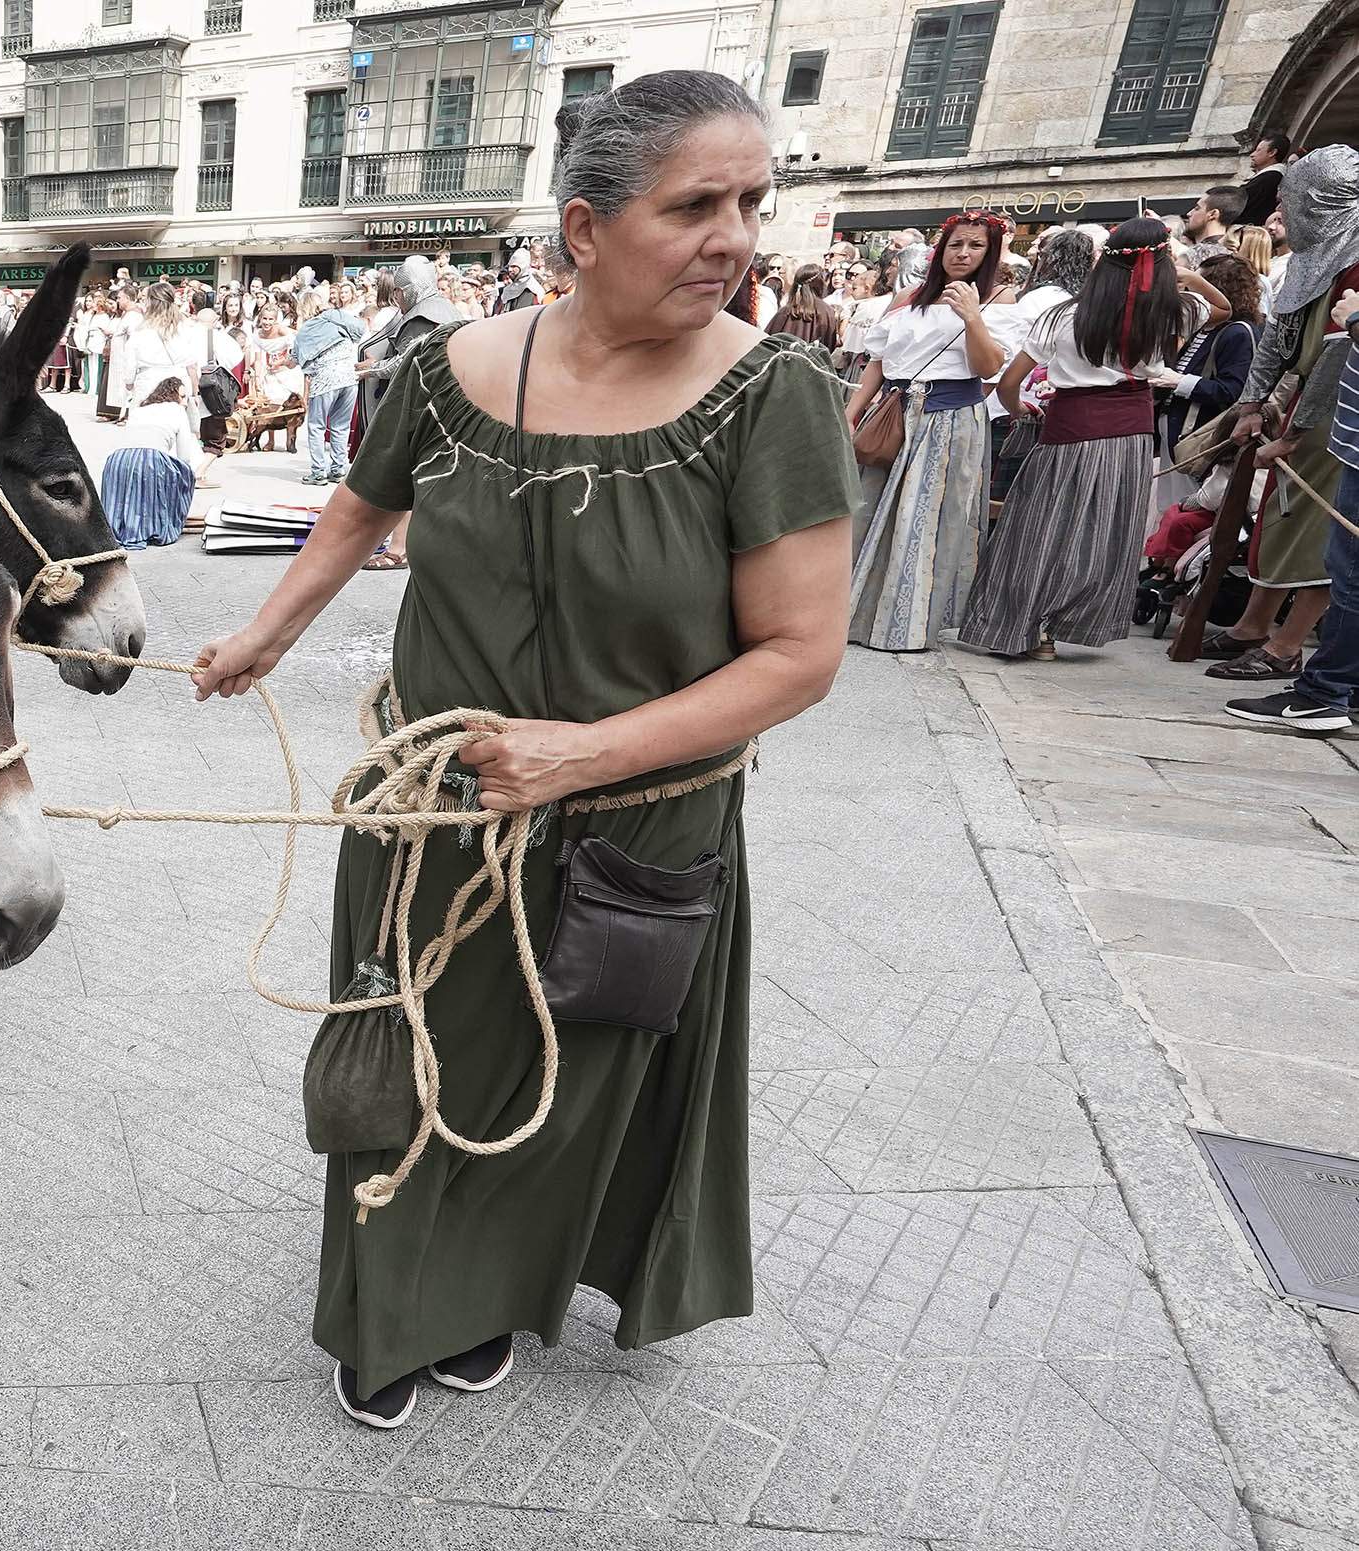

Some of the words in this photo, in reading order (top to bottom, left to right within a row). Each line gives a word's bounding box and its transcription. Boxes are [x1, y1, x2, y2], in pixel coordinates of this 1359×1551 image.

[363, 217, 488, 236] INMOBILIARIA
[381, 239, 453, 250] PEDROSA
[144, 262, 206, 275] ARESSO
